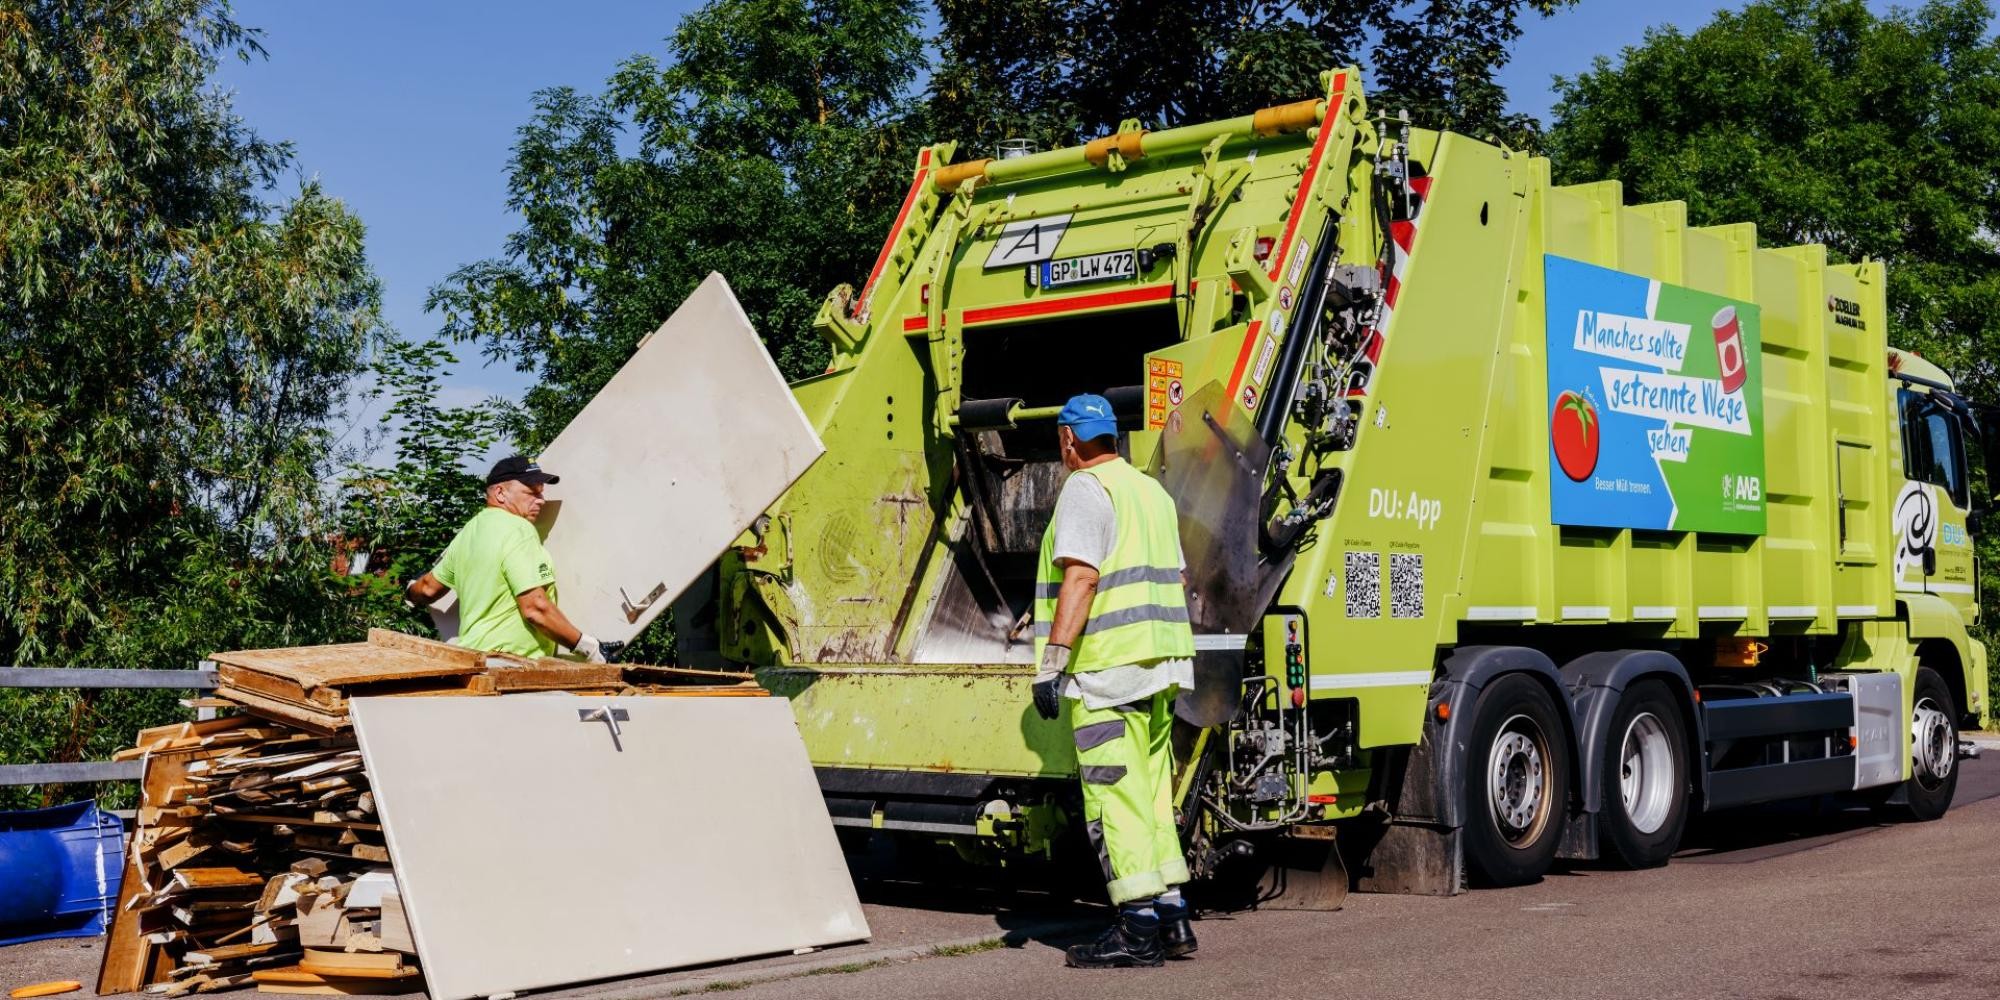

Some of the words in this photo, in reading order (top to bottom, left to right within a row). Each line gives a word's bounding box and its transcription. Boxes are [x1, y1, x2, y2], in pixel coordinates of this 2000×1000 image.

[1002, 223, 1040, 260] A
[1051, 262, 1070, 282] GP
[1080, 258, 1100, 278] LW
[1103, 253, 1133, 274] 472
[1583, 311, 1643, 350] Manches
[1647, 329, 1683, 360] sollte
[1611, 373, 1697, 415] getrennte
[1702, 380, 1743, 425] Wege
[1650, 423, 1689, 454] gehen.
[1595, 476, 1615, 492] Besser
[1735, 475, 1761, 501] AWB
[1369, 488, 1402, 519] DU:
[1406, 491, 1441, 531] App
